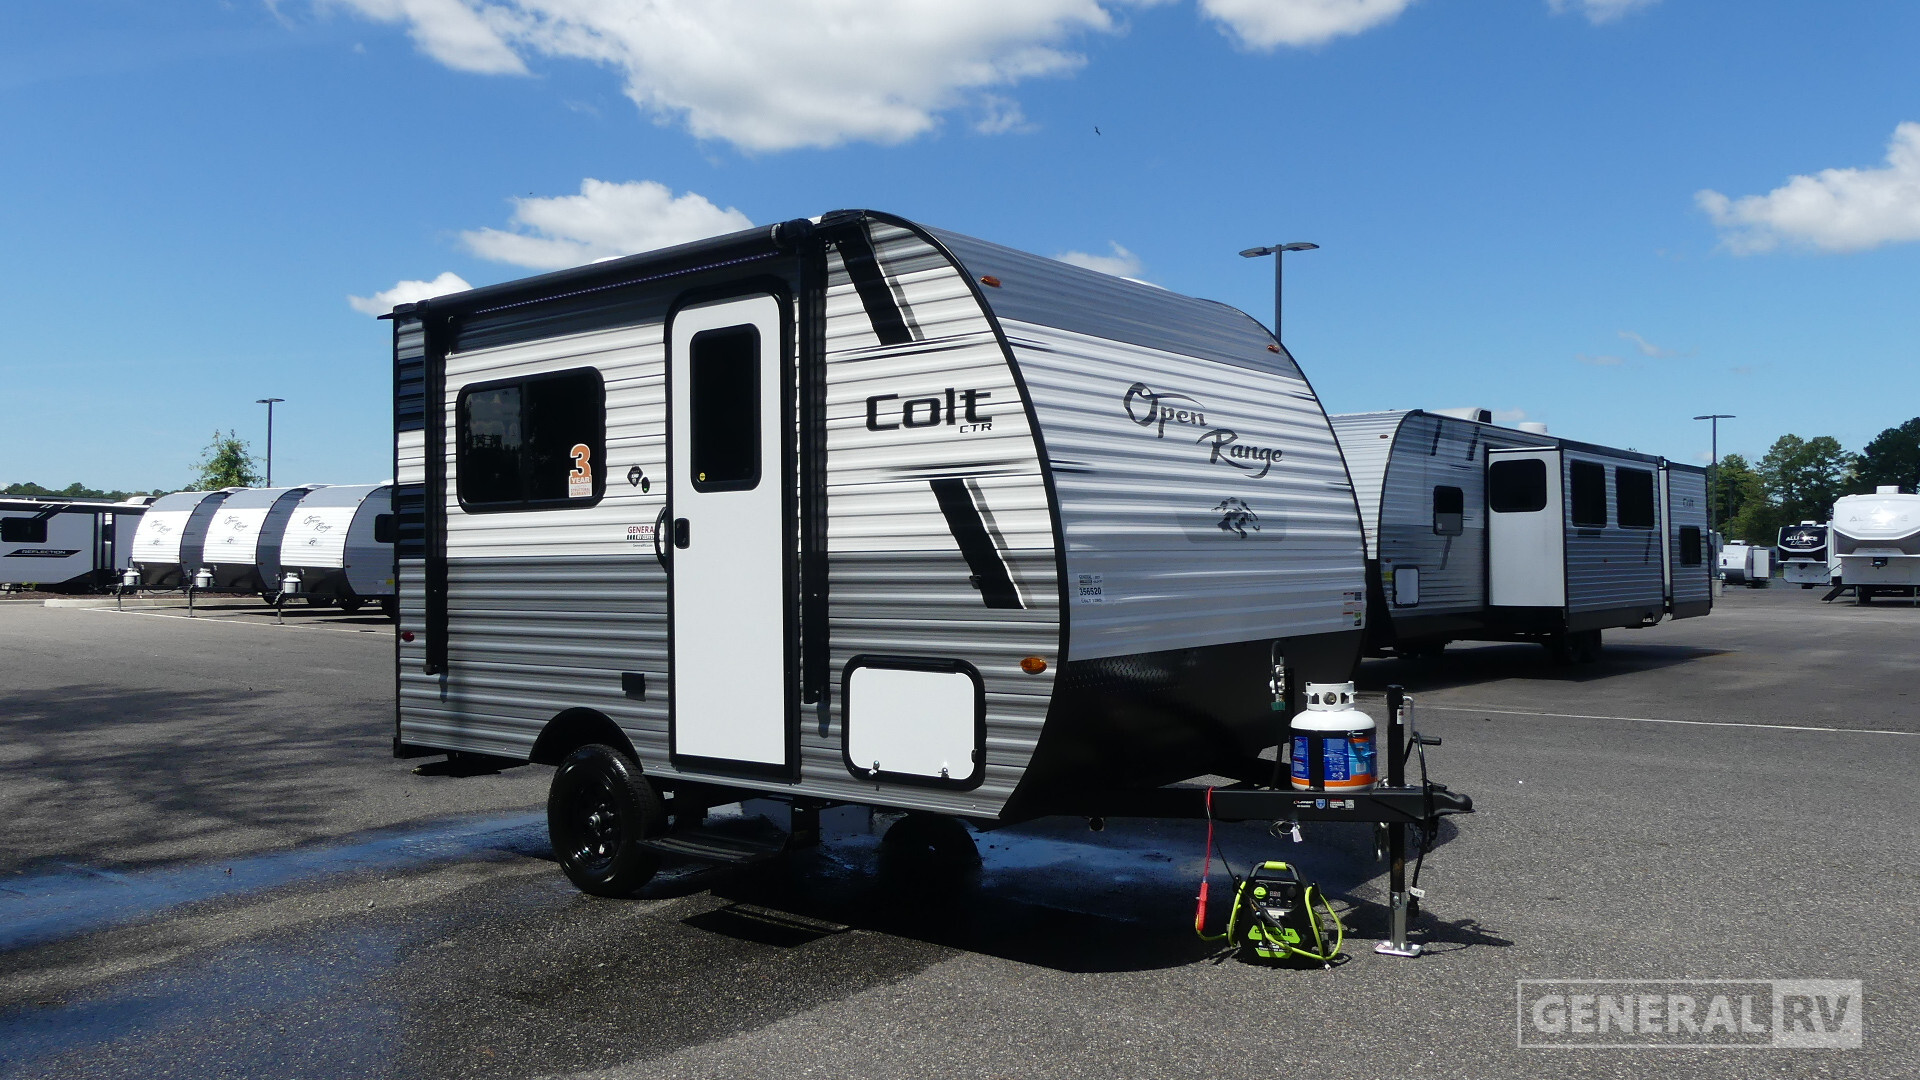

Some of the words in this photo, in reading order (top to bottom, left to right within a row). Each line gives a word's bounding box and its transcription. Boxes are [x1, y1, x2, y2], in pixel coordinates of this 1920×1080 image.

[866, 387, 993, 432] Colt
[960, 422, 993, 434] CTR
[1123, 382, 1208, 439] Open
[570, 443, 591, 477] 3
[1196, 428, 1283, 479] Range
[627, 525, 655, 534] GENERA
